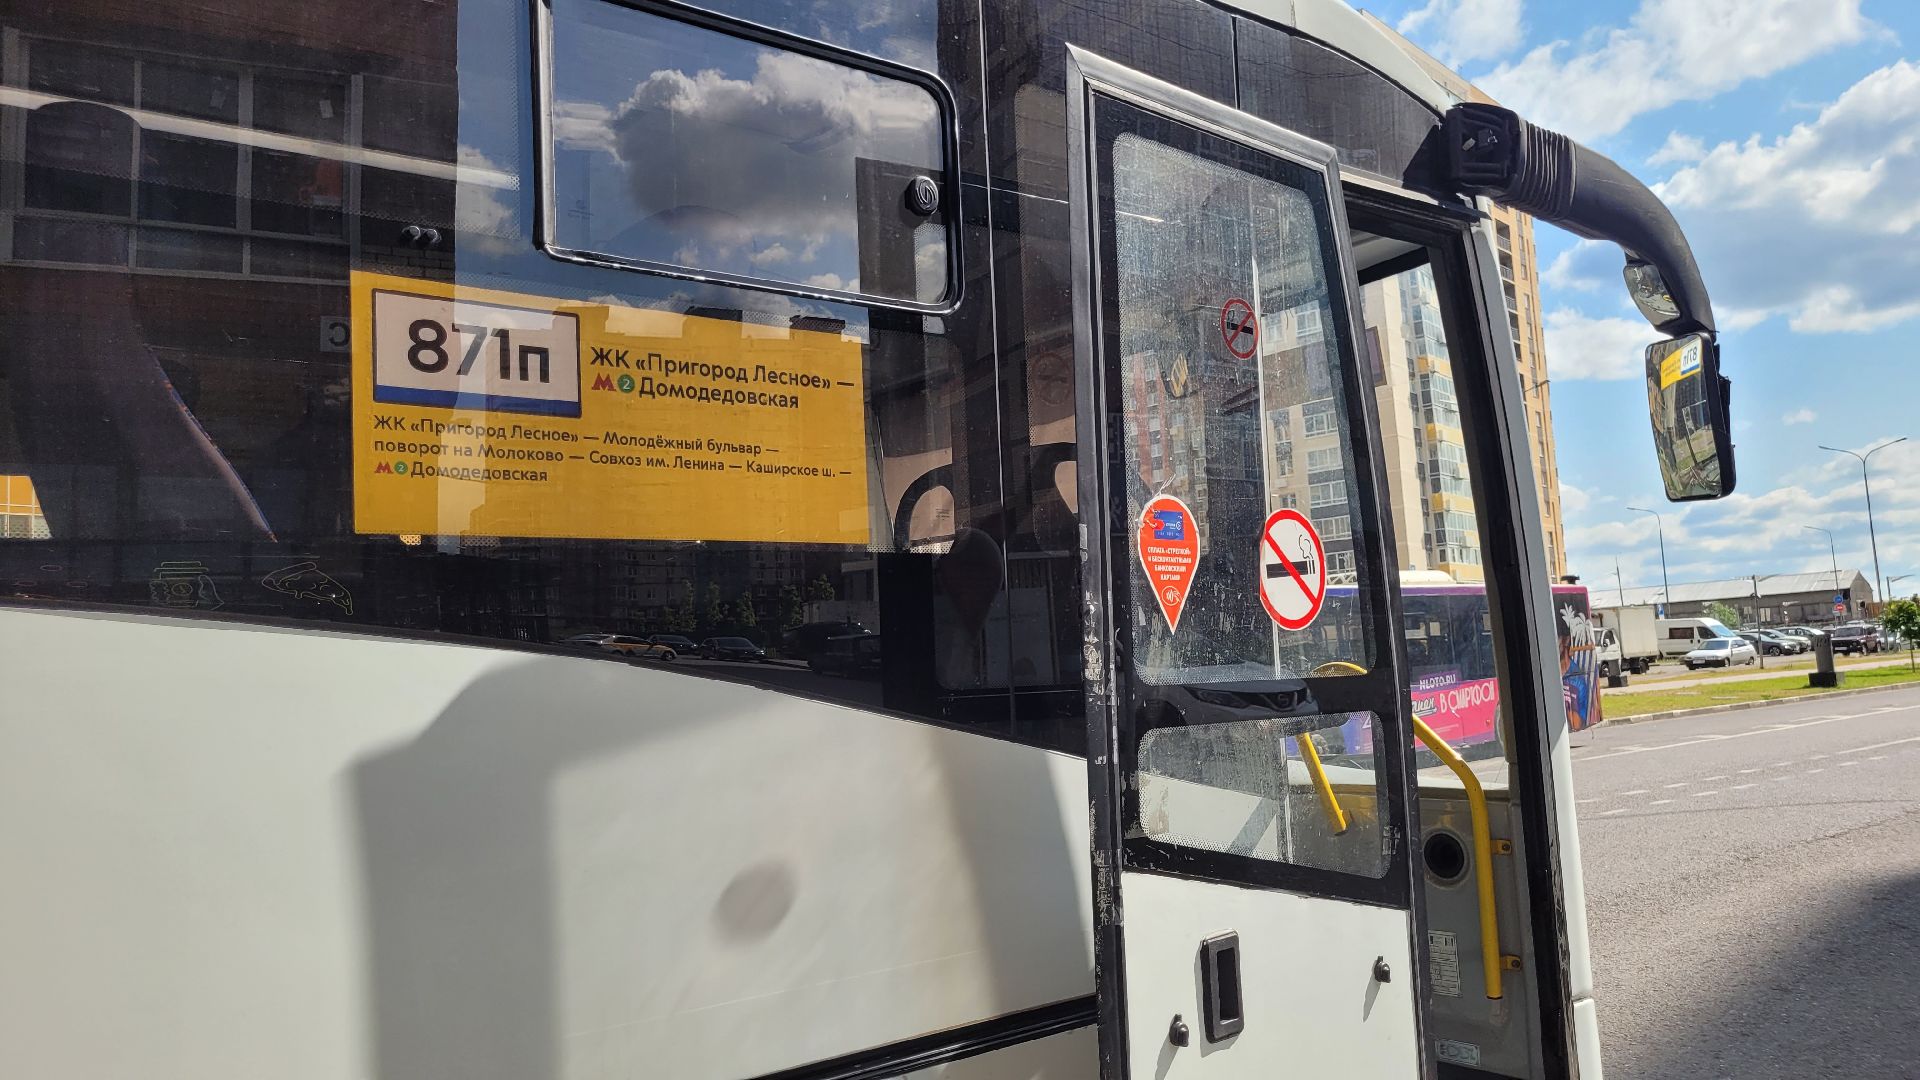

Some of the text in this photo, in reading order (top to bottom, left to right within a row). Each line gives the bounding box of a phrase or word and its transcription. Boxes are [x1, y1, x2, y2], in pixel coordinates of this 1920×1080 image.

[407, 319, 550, 384] 871п
[590, 346, 630, 370] ЖК
[635, 353, 749, 384] «Пригород
[753, 365, 831, 390] Лесное»
[639, 376, 799, 409] Домодедовская
[374, 414, 407, 431] ЖК
[410, 418, 507, 440] «Пригород
[510, 425, 579, 442] Лесное»
[603, 431, 703, 451] Молодёжный
[707, 438, 762, 457] бульвар
[374, 440, 447, 457] поворот
[453, 445, 473, 456] на
[478, 443, 564, 462] Молоково
[589, 451, 642, 466] Совхоз
[646, 457, 670, 468] им.
[673, 456, 725, 471] Ленина
[746, 460, 819, 477] Каширское
[822, 468, 837, 478] ш.
[410, 461, 548, 481] Домодедовская
[1419, 674, 1456, 690] NLOTO.RU
